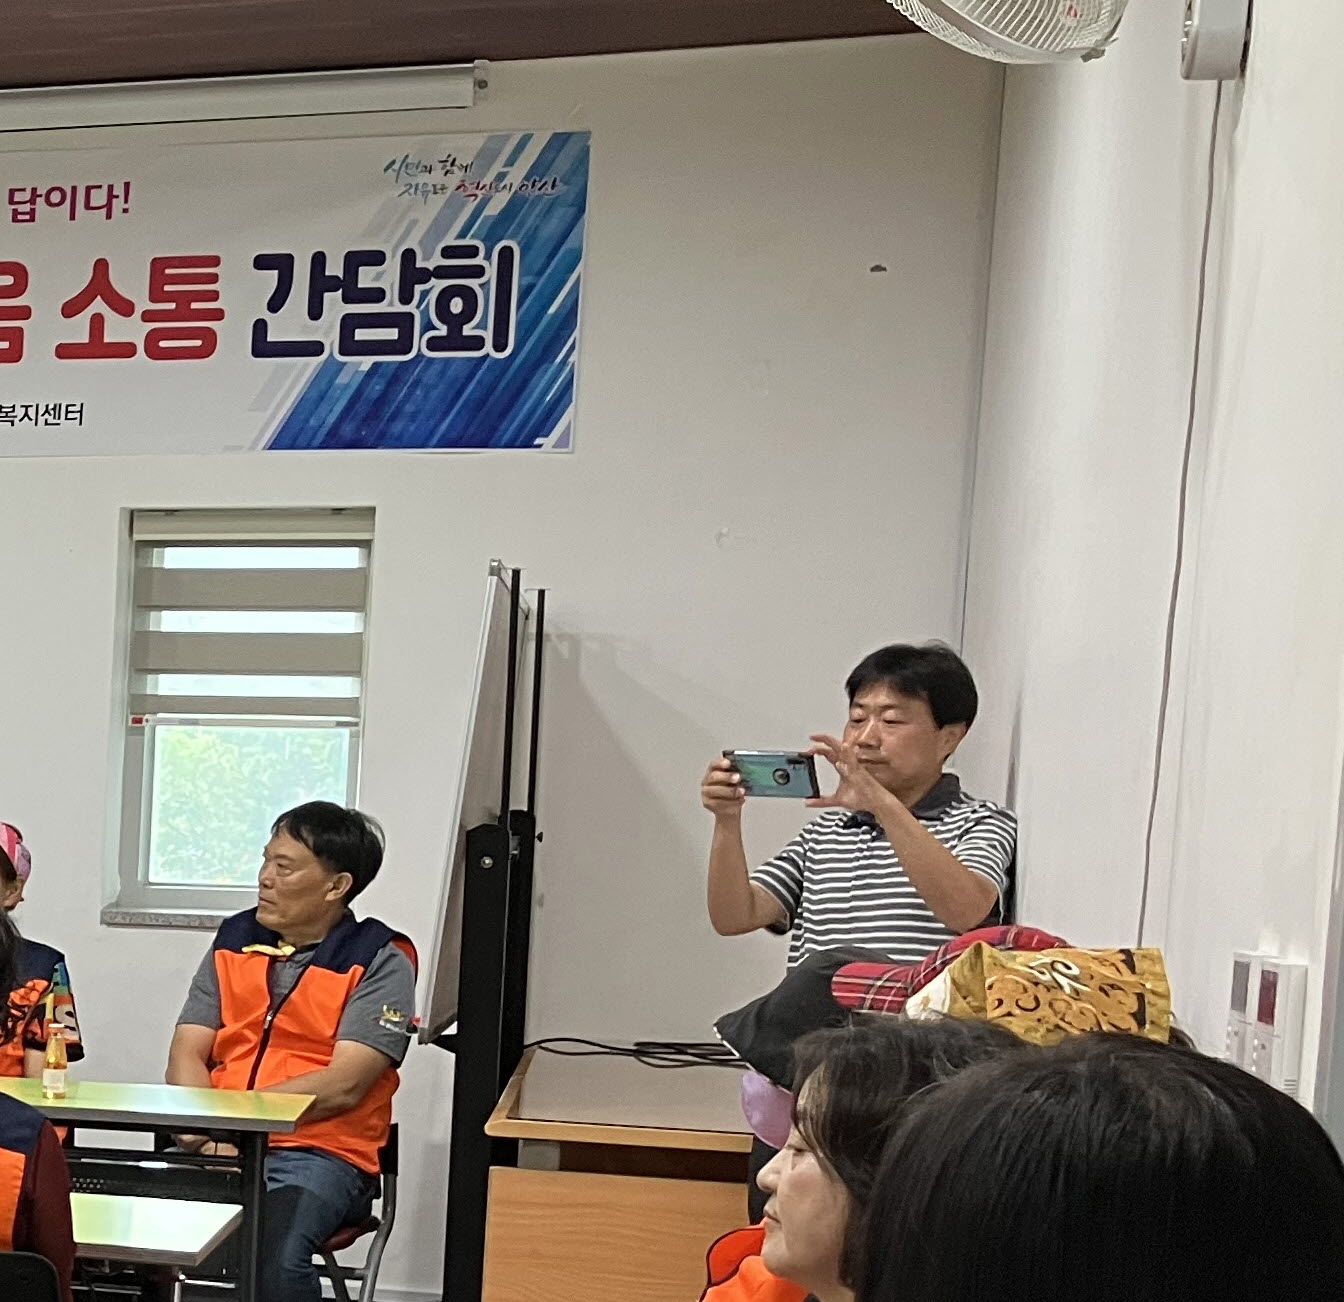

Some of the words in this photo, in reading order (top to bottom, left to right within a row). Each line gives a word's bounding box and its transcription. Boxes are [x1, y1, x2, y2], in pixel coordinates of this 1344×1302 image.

[7, 181, 132, 224] 답이다!
[54, 254, 226, 361] 소통
[250, 244, 516, 358] 간담회
